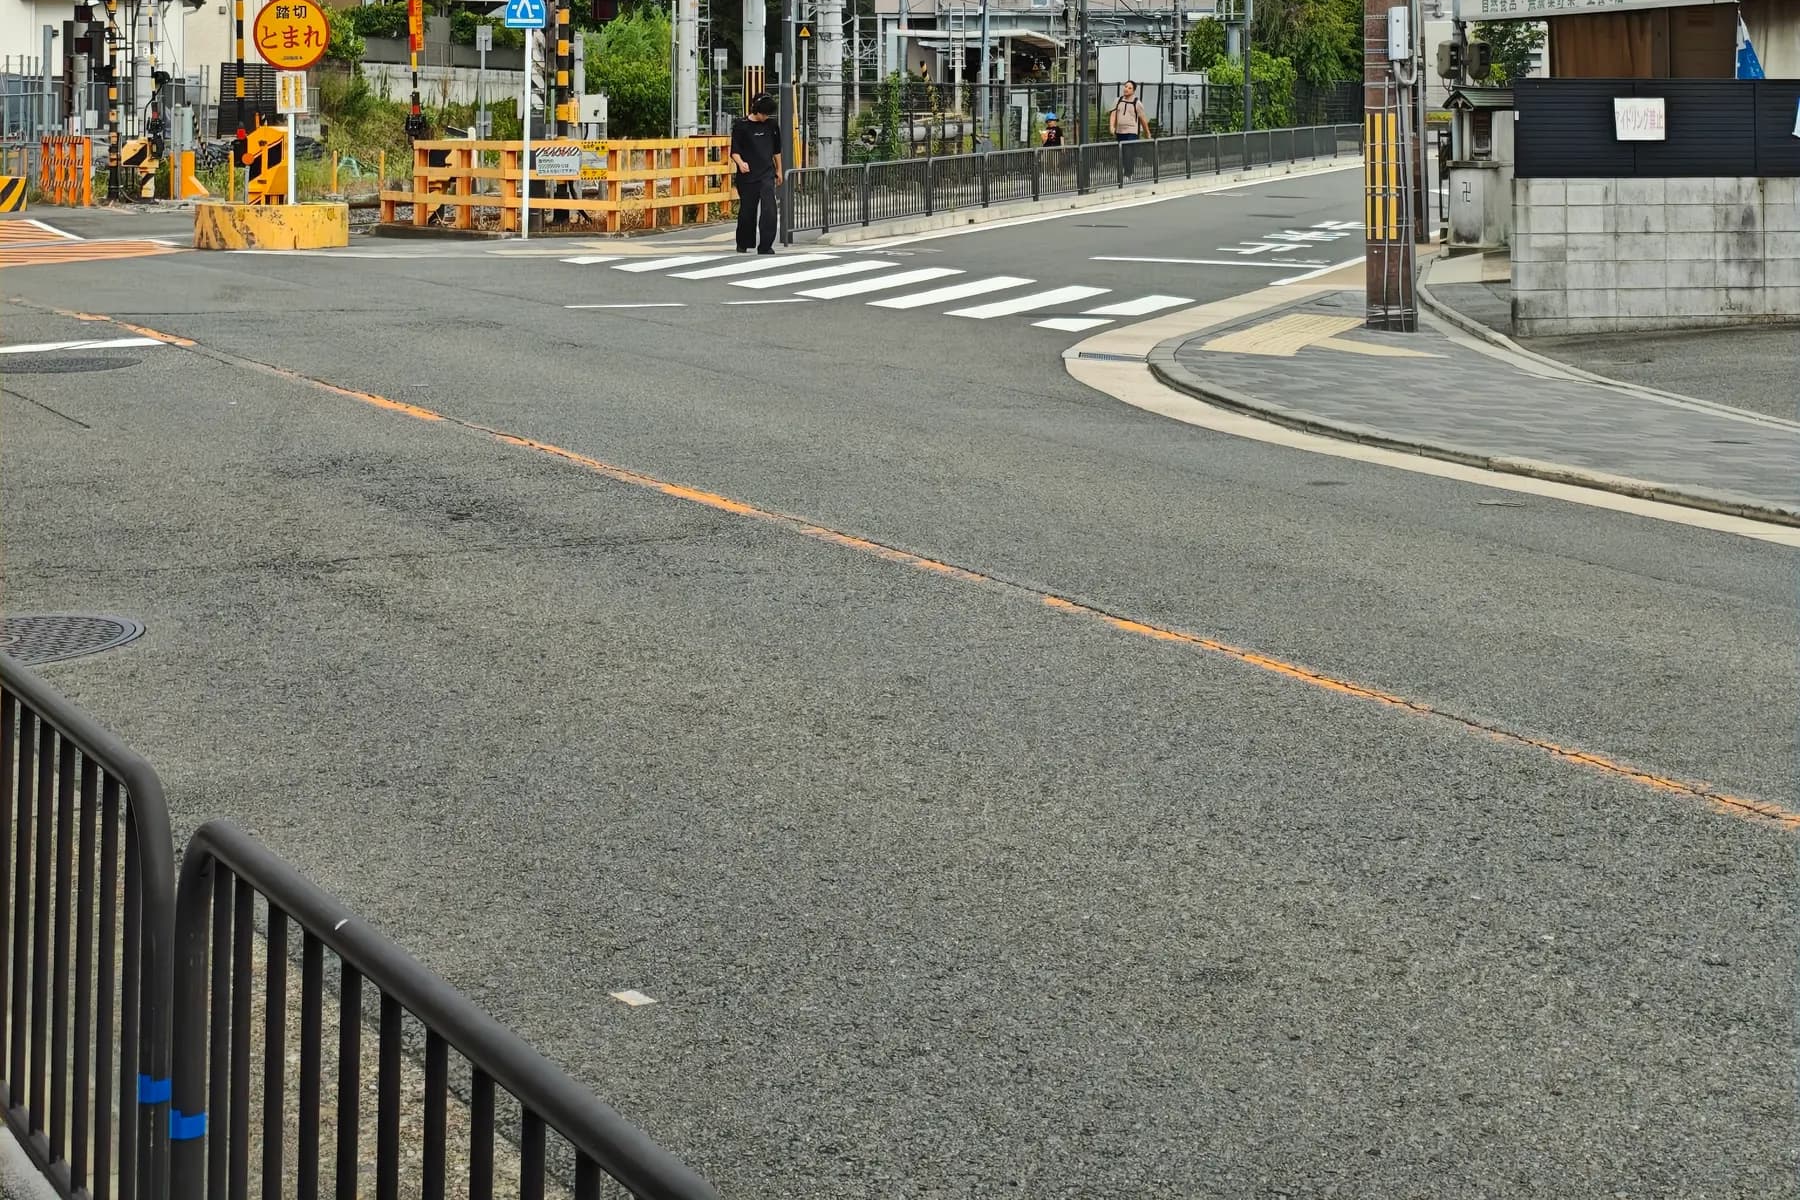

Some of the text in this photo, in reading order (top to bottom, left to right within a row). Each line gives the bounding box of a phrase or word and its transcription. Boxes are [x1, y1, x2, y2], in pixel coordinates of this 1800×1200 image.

[276, 5, 307, 19] 踏切
[260, 25, 323, 49] とまれ
